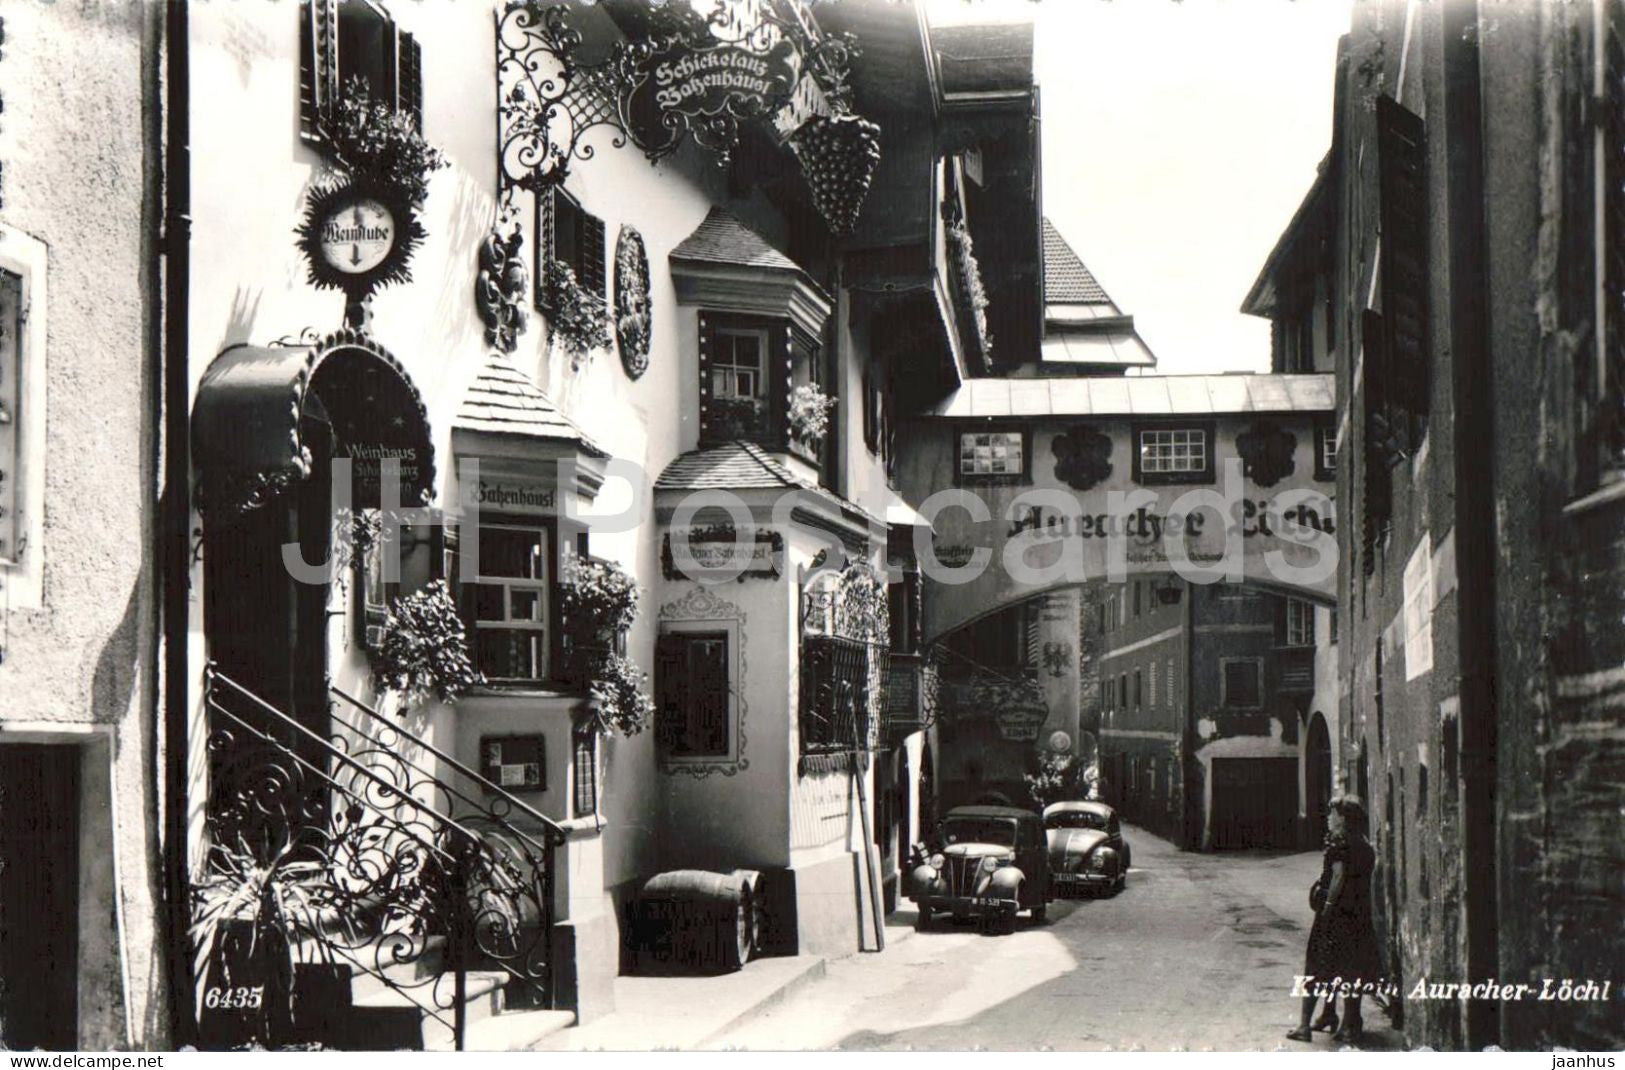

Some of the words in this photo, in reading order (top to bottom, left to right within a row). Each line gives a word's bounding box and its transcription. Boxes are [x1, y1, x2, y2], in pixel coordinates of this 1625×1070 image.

[323, 222, 389, 243] Weinstube
[345, 443, 416, 461] Weinhaus
[1007, 502, 1205, 547] Auracher
